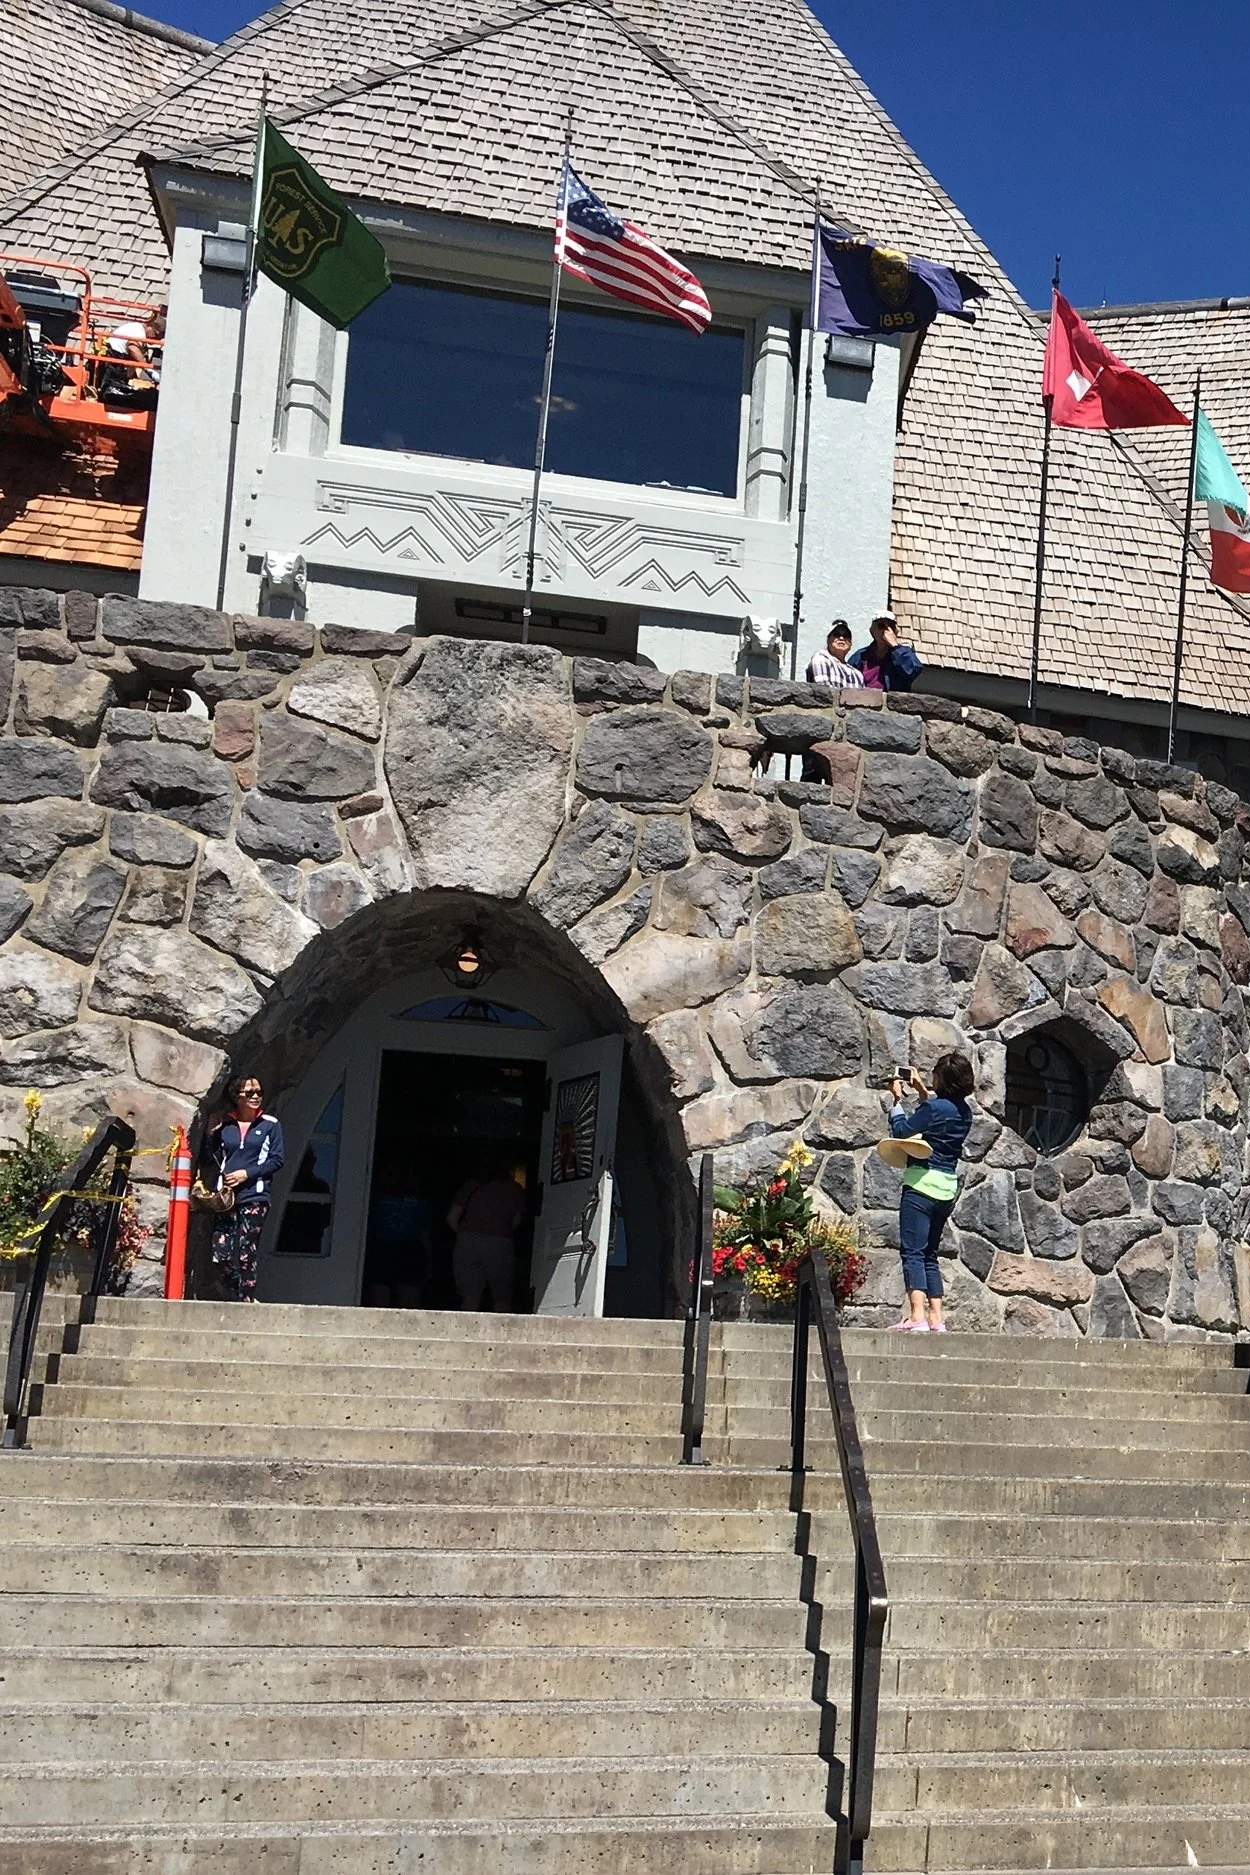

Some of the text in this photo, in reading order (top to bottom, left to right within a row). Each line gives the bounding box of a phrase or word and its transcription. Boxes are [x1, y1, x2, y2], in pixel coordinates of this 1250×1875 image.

[274, 182, 328, 234] FOREST SERVICE
[879, 311, 916, 329] 1859
